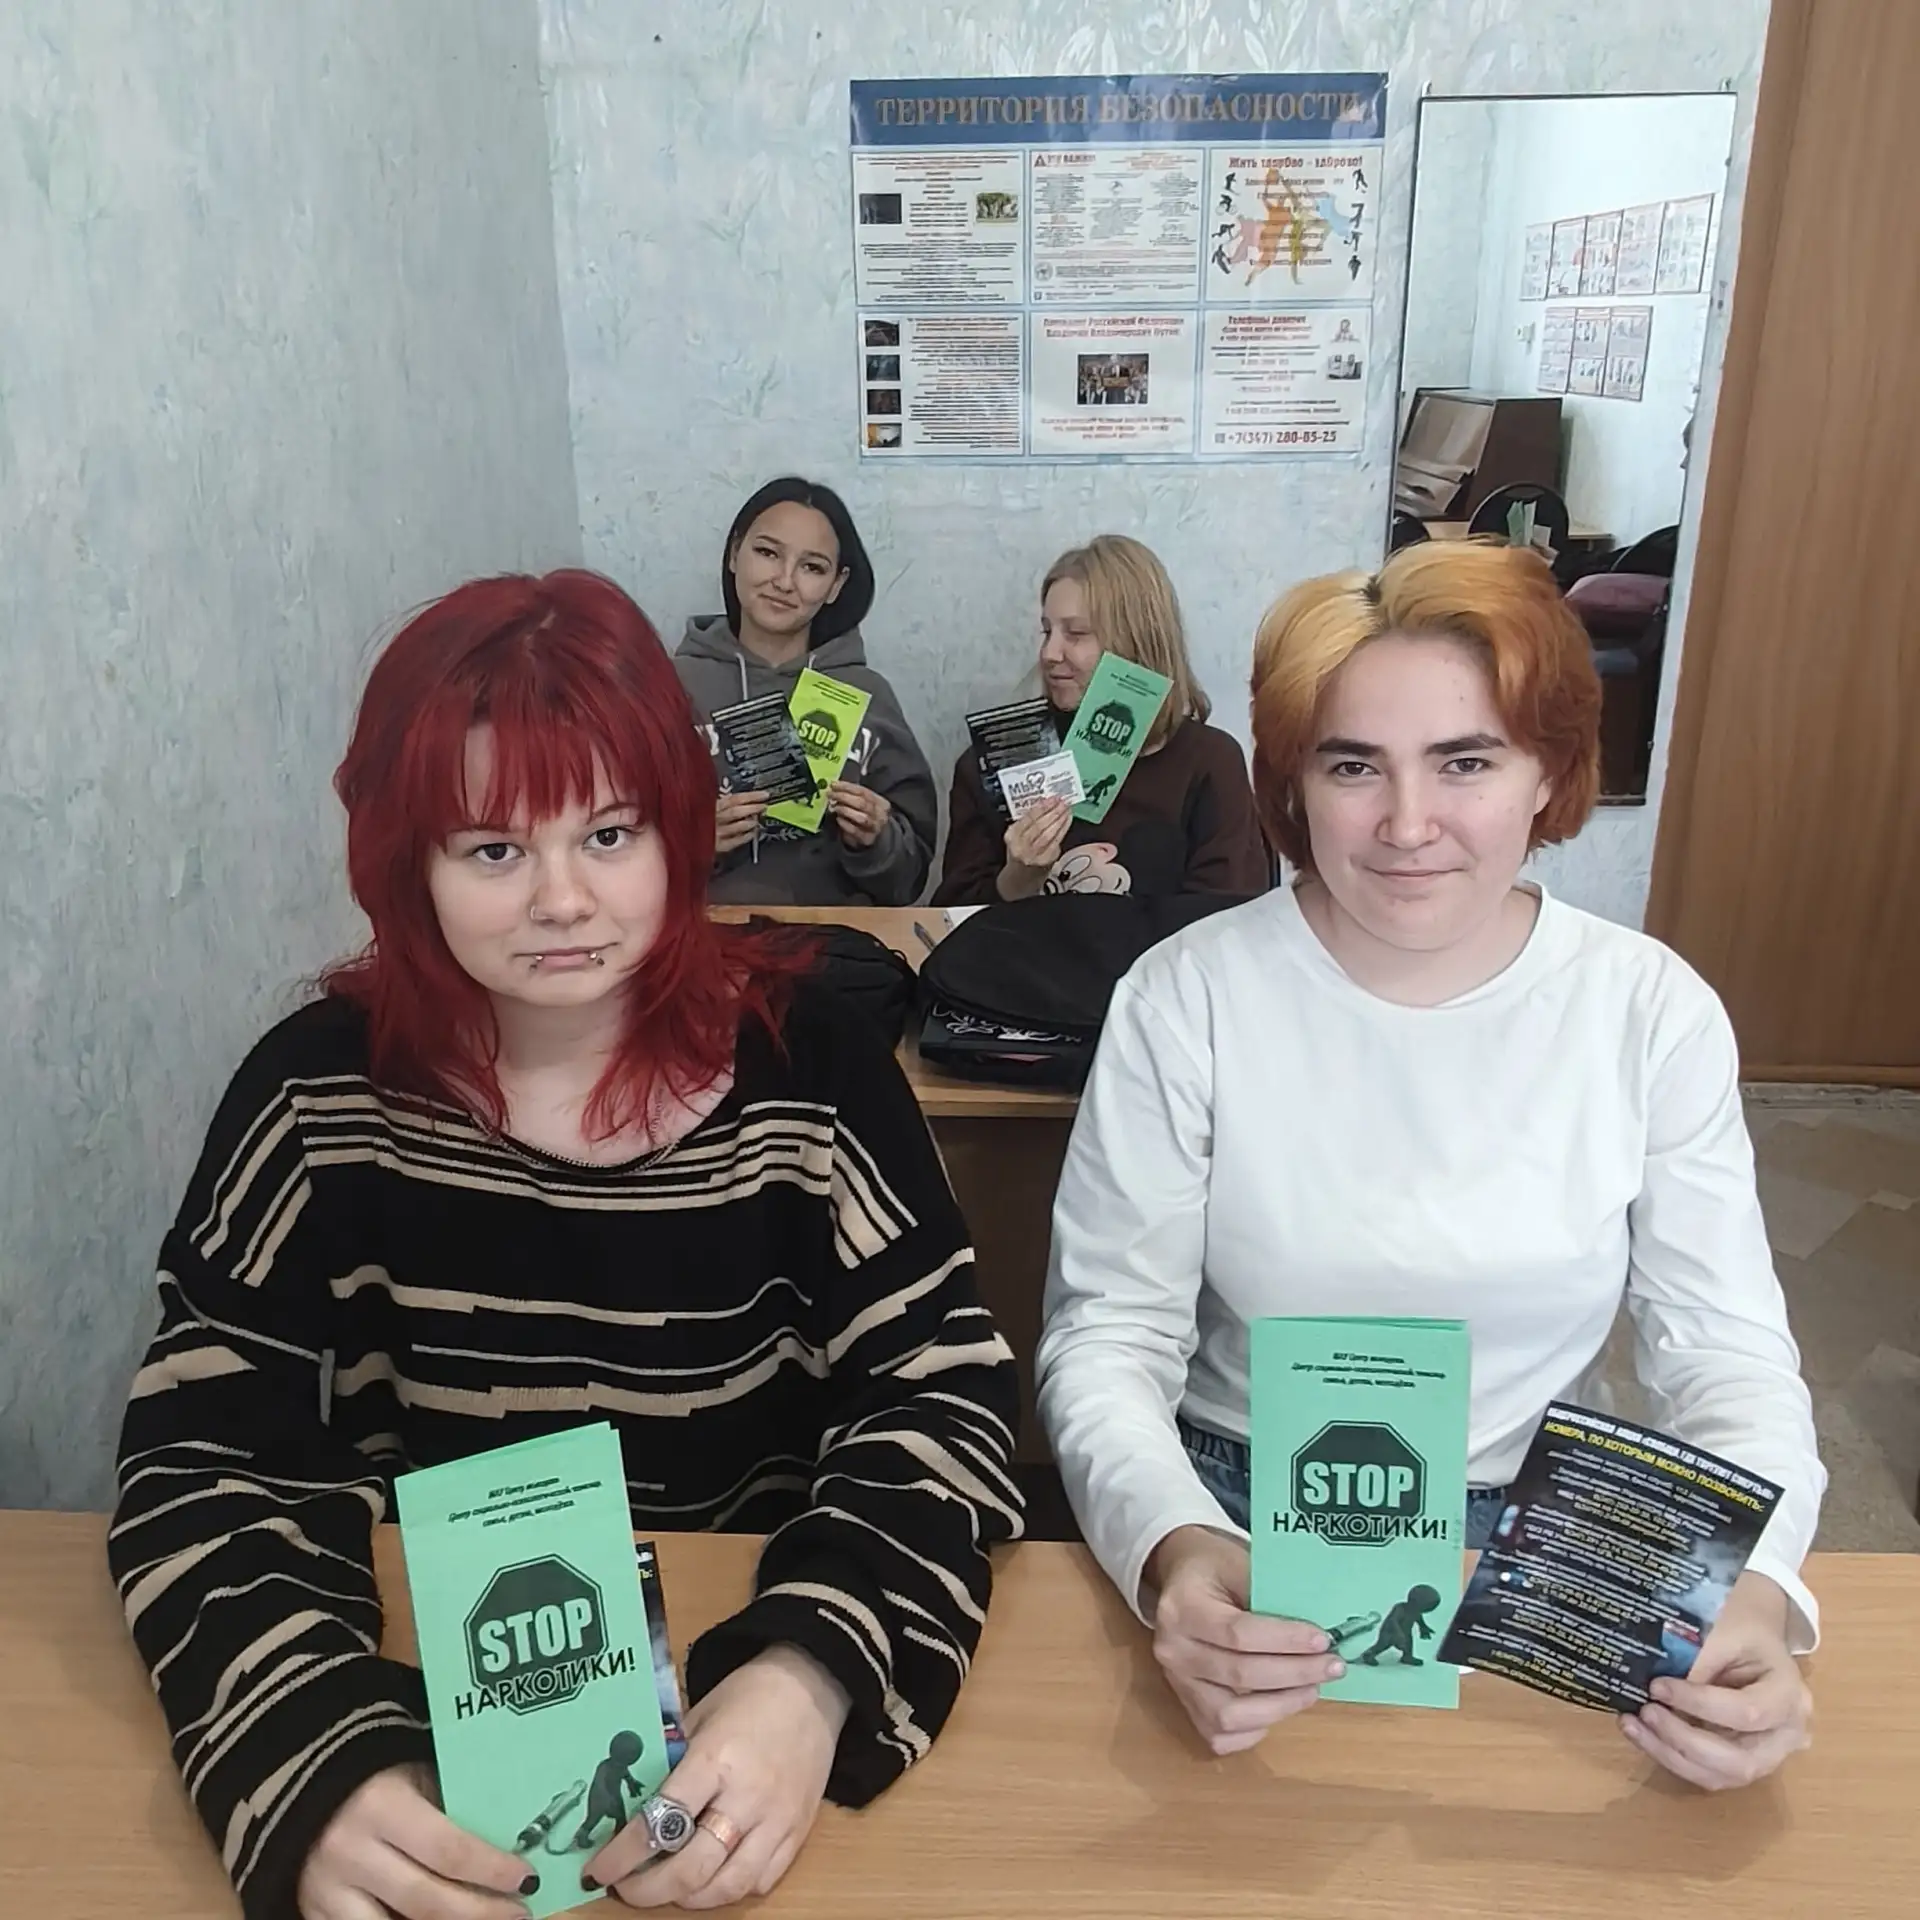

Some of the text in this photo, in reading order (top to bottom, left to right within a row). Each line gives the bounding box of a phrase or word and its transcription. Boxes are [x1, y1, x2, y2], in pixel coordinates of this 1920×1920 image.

[876, 91, 1365, 126] ТЕРРИТОРИЯ БЕЗОПАСНОСТИ
[799, 720, 837, 747] STOP
[1091, 713, 1131, 742] STOP
[1588, 1433, 1604, 1446] ПО
[1603, 1438, 1656, 1465] КОТОРЫМ
[1655, 1457, 1697, 1480] МОЖНО
[1302, 1461, 1414, 1508] STOP
[1273, 1511, 1448, 1540] НАРКОТИКИ!
[478, 1597, 593, 1673] STOP
[454, 1646, 637, 1721] НАРКОТИКИ!
